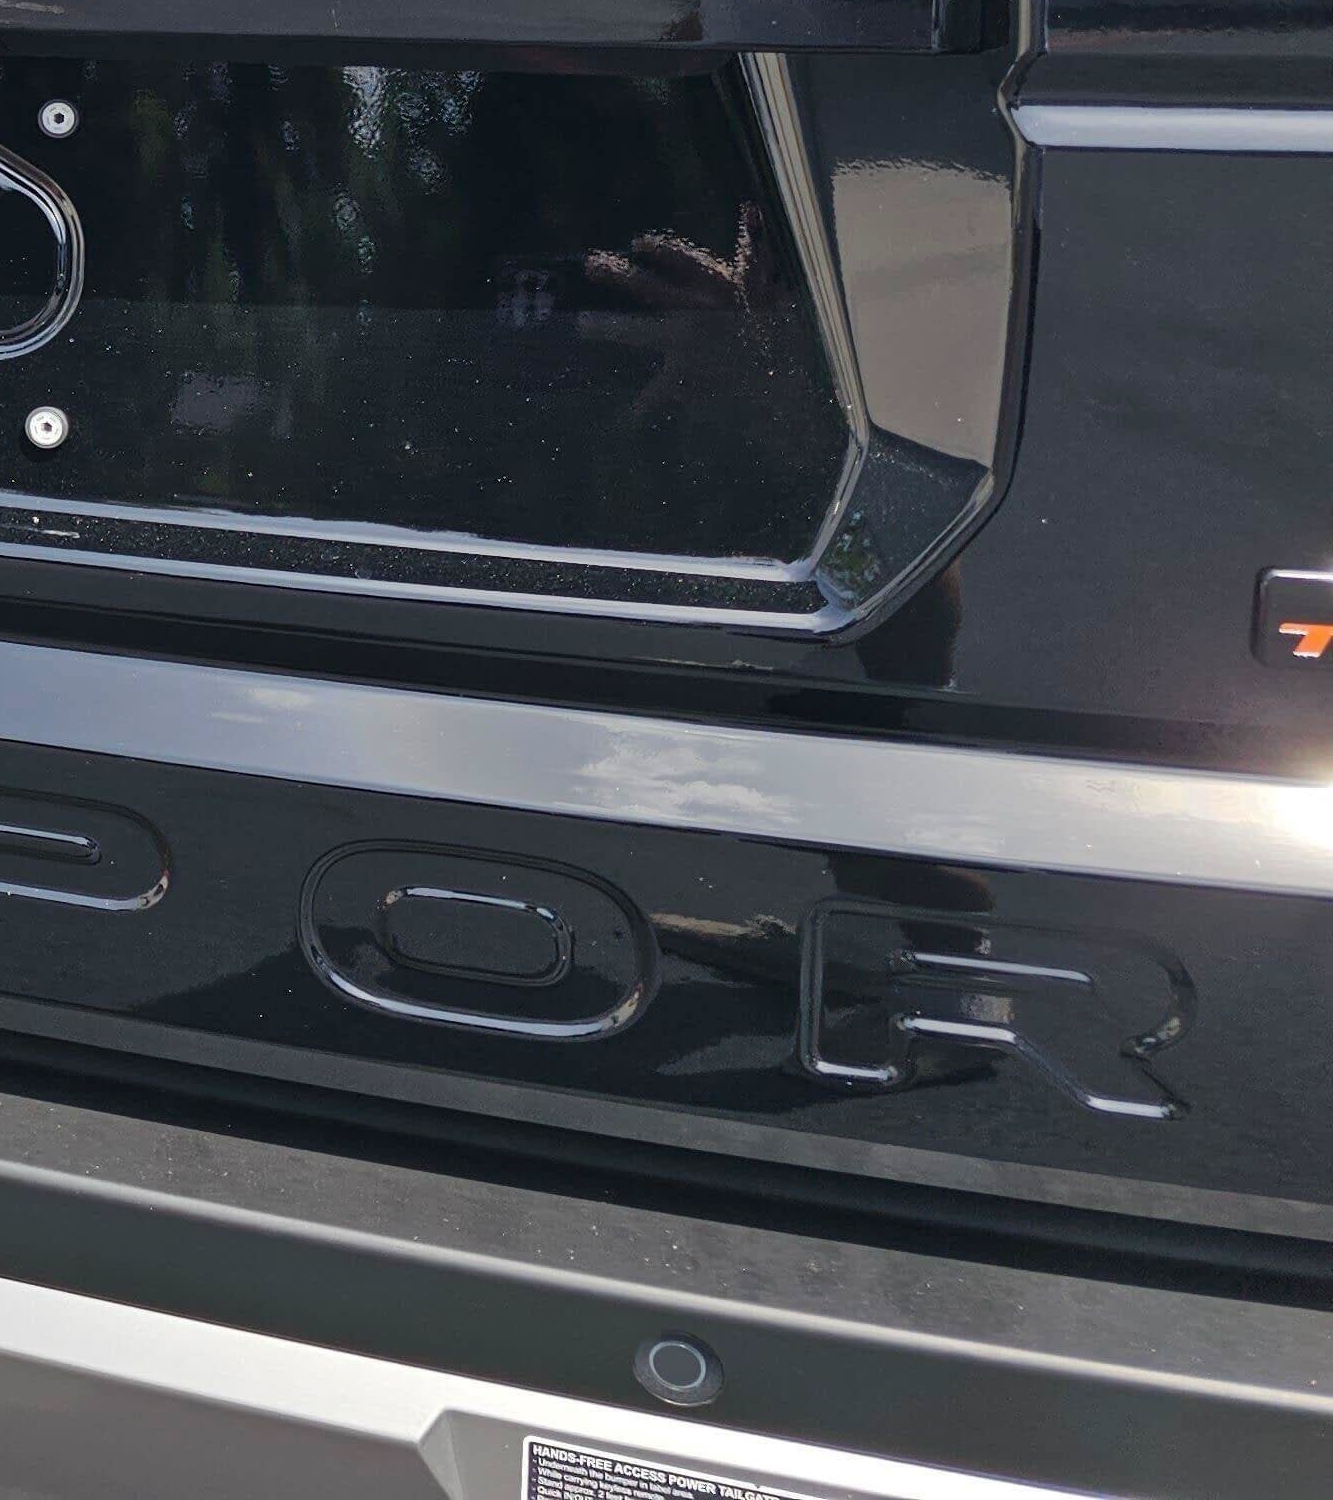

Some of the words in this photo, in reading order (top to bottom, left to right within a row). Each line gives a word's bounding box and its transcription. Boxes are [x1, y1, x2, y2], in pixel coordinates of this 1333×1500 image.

[532, 1444, 612, 1471] HANDS-FREE
[614, 1462, 667, 1484] ACCESS
[668, 1474, 717, 1495] POWER
